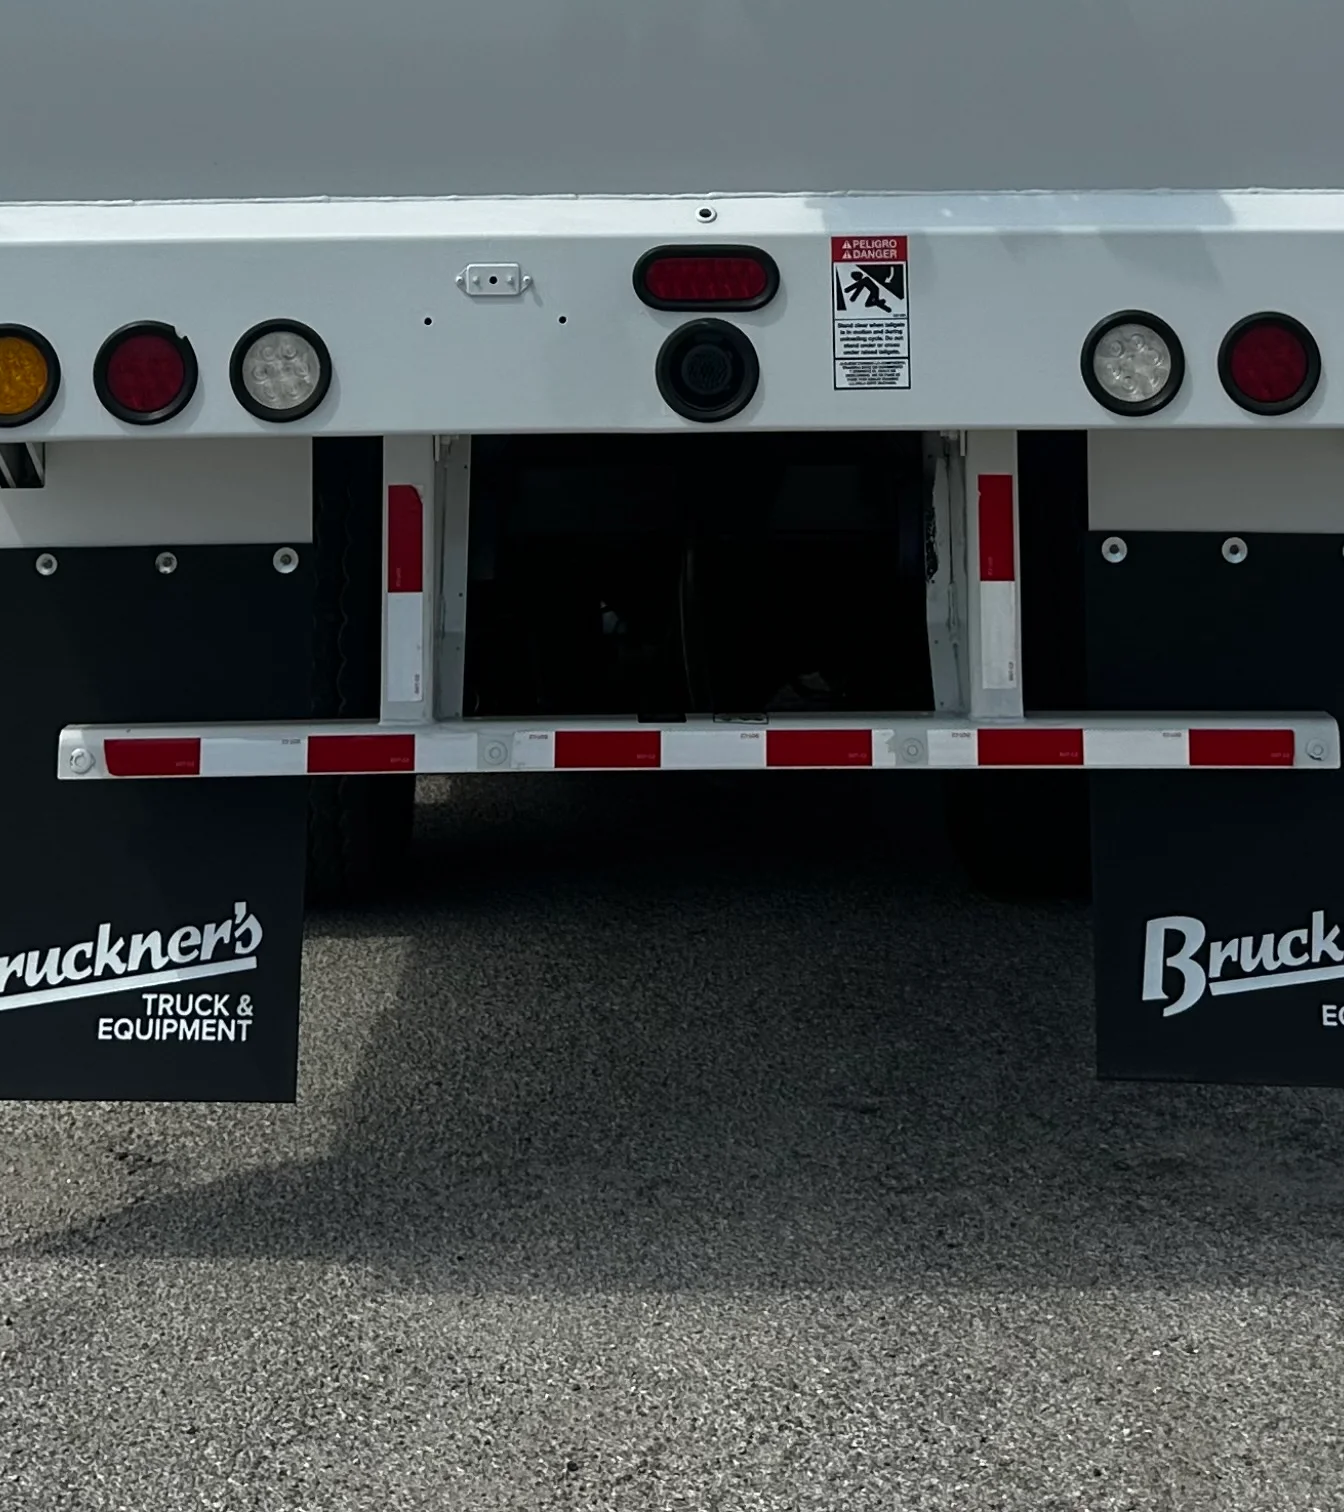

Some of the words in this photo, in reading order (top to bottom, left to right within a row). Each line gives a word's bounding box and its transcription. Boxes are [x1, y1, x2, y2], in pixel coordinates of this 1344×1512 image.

[852, 239, 897, 248] PELIGRO
[852, 249, 897, 259] DANGER
[142, 993, 230, 1016] TRUCK
[236, 994, 254, 1017] &
[97, 1017, 253, 1041] EQUIPMENT
